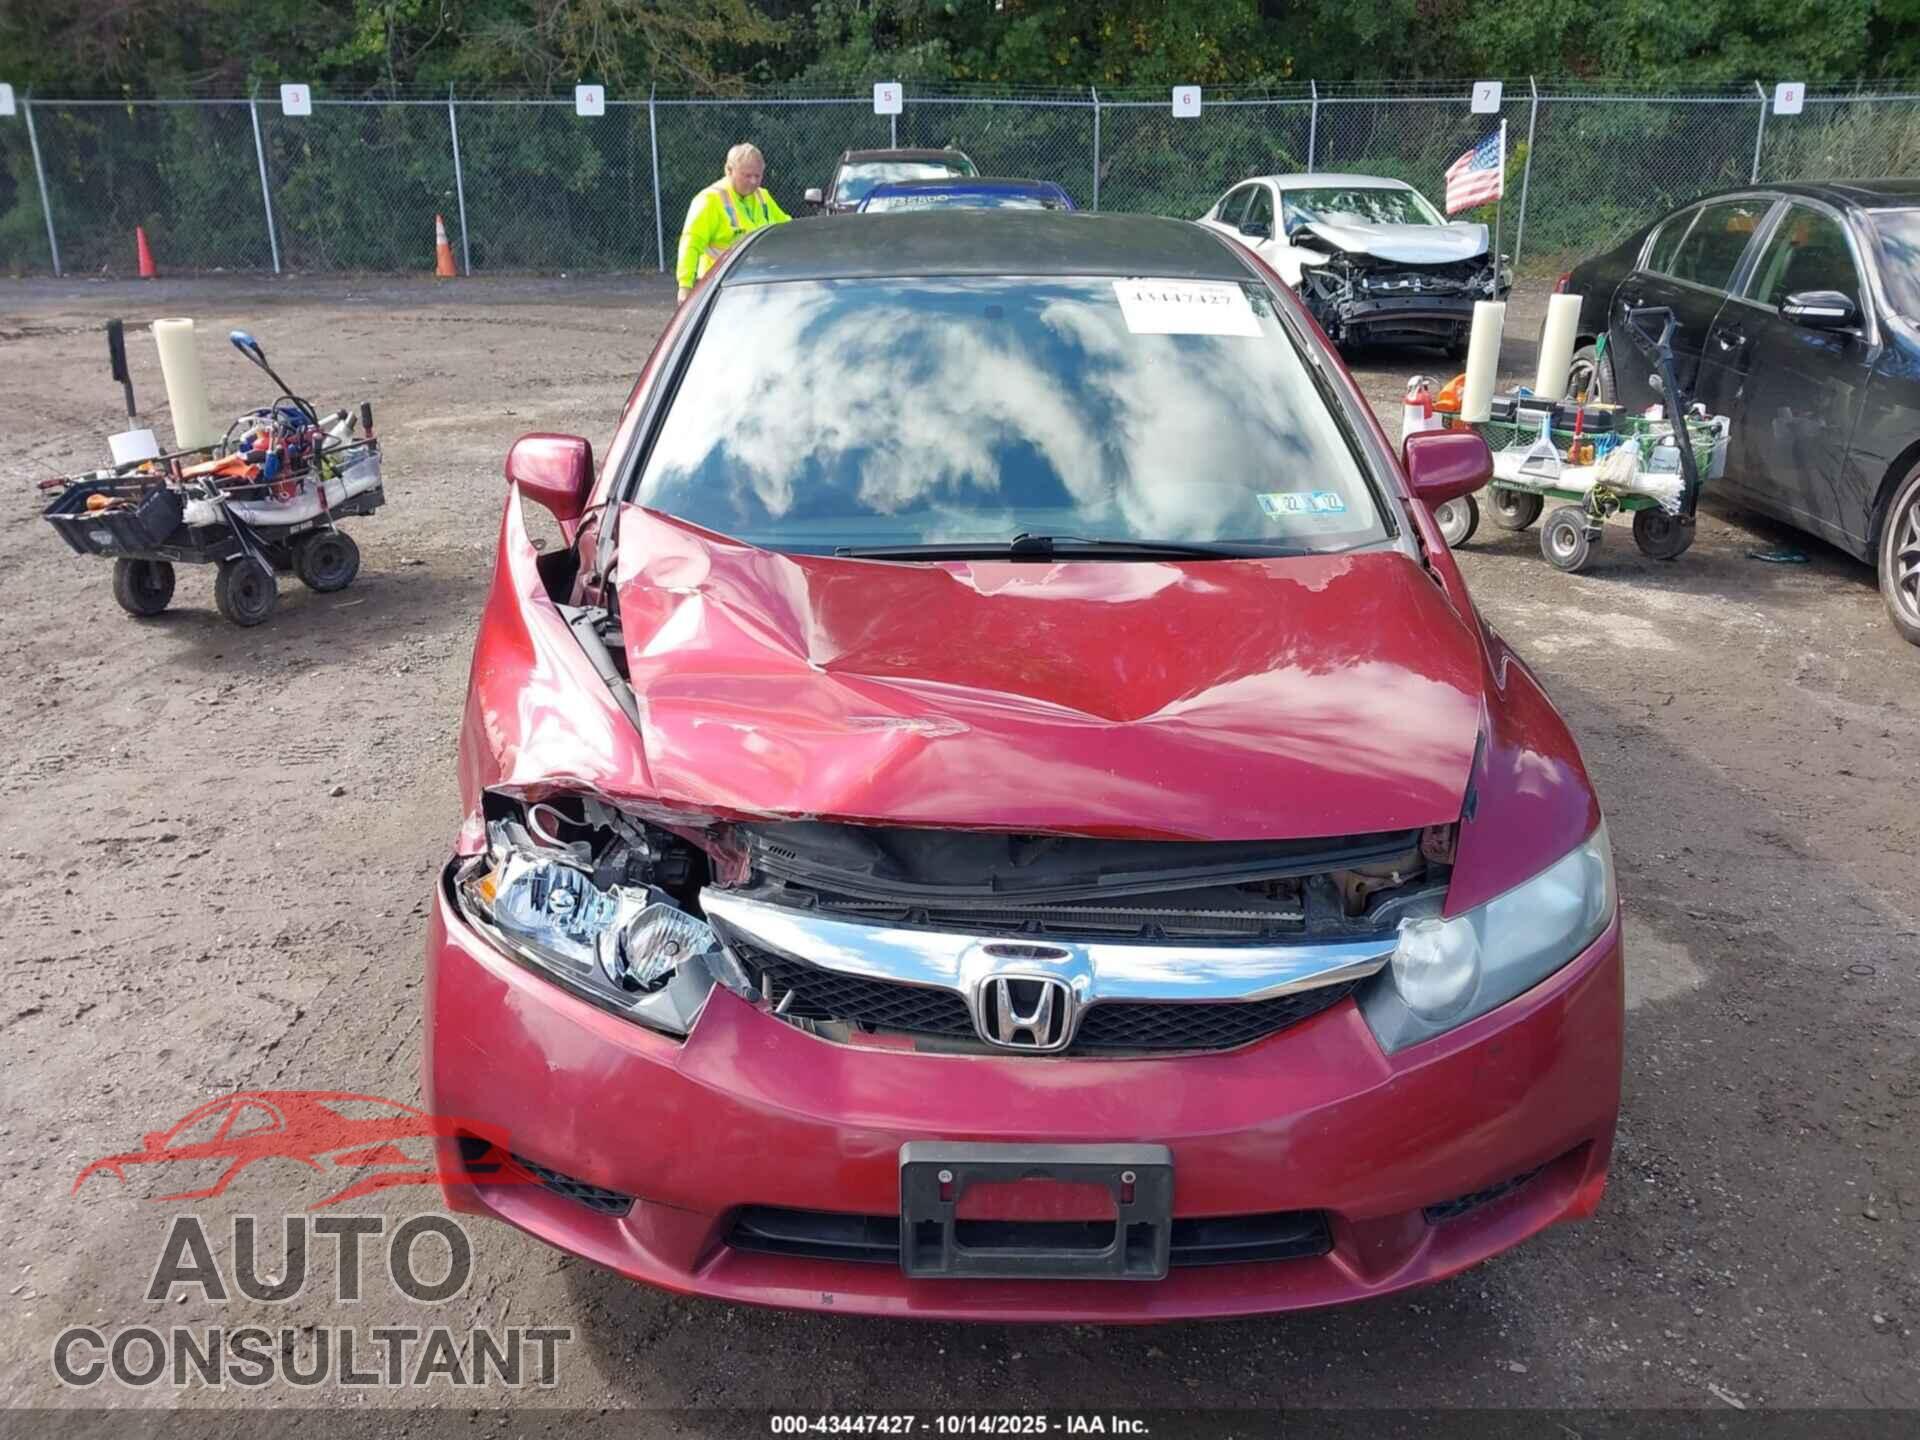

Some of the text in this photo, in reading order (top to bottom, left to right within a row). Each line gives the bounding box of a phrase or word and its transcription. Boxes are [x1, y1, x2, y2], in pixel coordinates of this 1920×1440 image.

[289, 92, 299, 103] 3
[586, 92, 595, 103] 4
[884, 91, 892, 102] 5
[1183, 94, 1191, 104] 6
[1483, 90, 1491, 101] 7
[1785, 91, 1793, 102] 8
